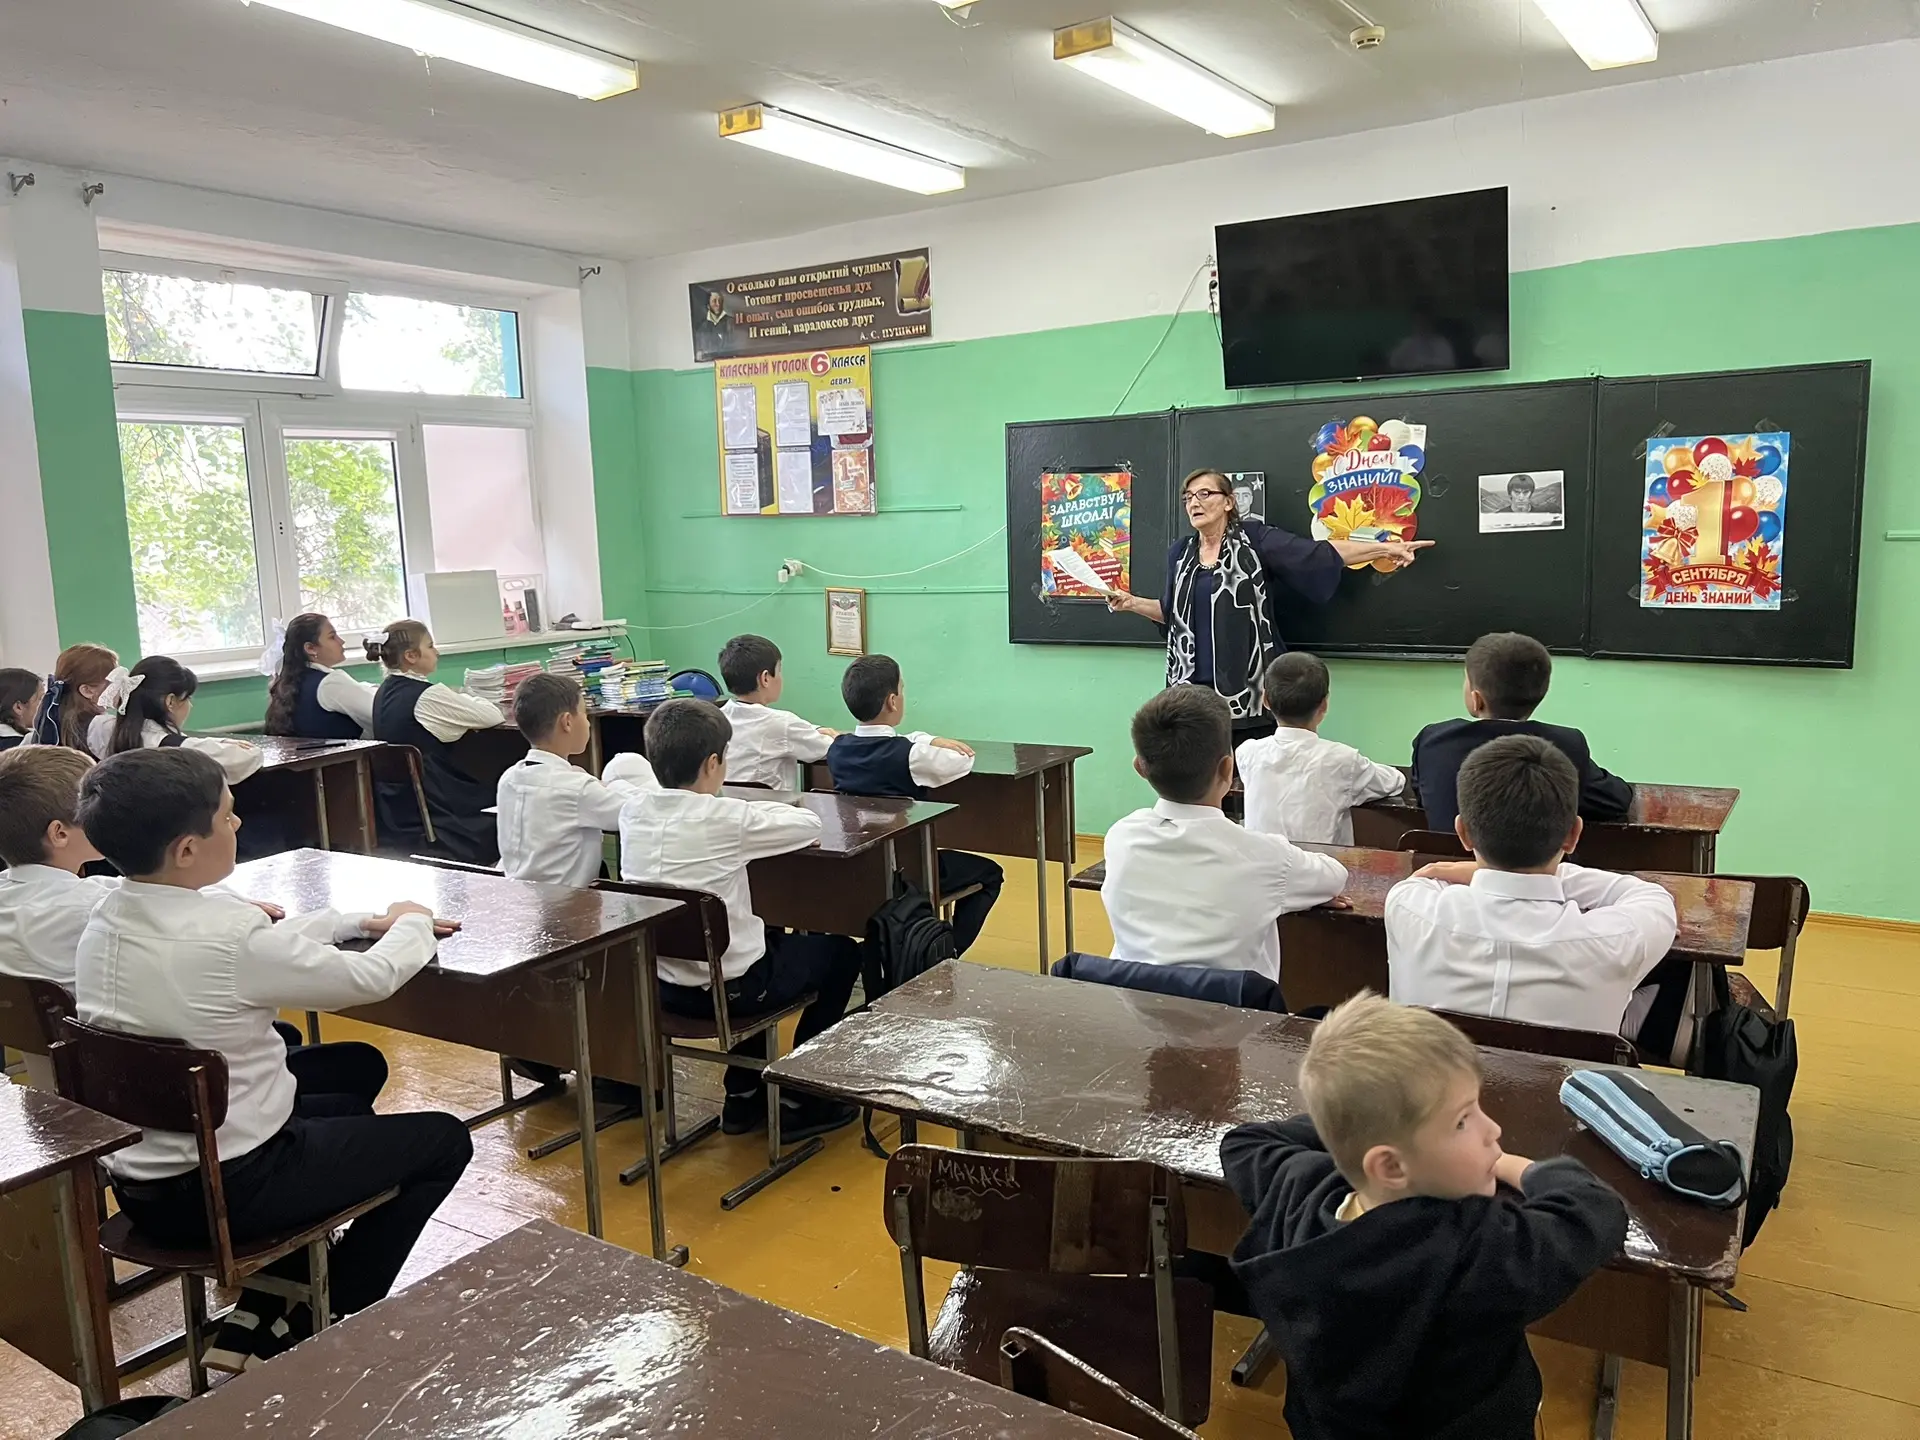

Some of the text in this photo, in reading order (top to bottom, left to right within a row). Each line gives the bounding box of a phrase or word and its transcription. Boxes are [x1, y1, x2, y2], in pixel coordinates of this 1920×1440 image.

[726, 261, 891, 293] О сколько нам открытий чудных
[745, 282, 872, 307] Готовят просвещенья дух
[736, 296, 885, 324] И опыт, сын ошибок трудных,
[749, 314, 874, 338] И гений, парадоксов друг
[882, 324, 926, 338] ПУШКИН
[720, 353, 865, 378] КЛАССНЫЙ УГОЛОК 6 КЛАССА
[1334, 449, 1396, 475] С Днем
[1327, 469, 1399, 493] ЗНАНИЙ!
[1061, 506, 1114, 528] ШКОЛА!
[1680, 480, 1733, 565] 1
[1672, 568, 1747, 584] СЕНТЯБРЯ
[1665, 588, 1753, 604] ДЕНЬ ЗНАНИЙ
